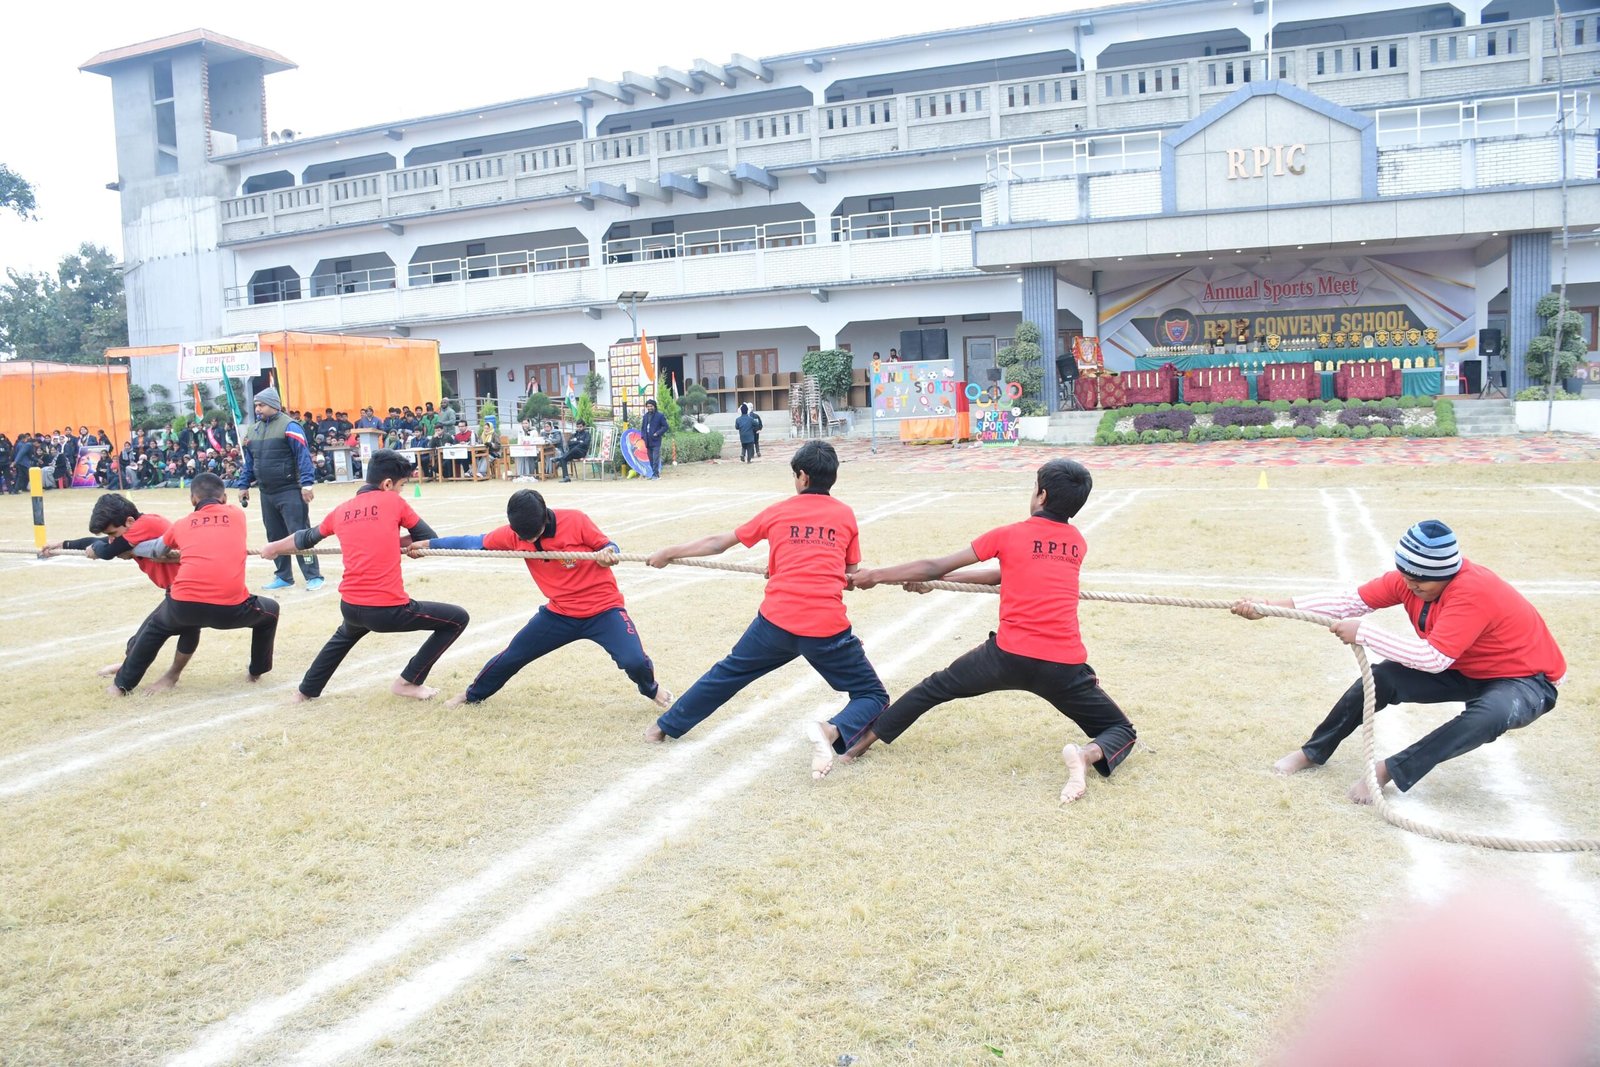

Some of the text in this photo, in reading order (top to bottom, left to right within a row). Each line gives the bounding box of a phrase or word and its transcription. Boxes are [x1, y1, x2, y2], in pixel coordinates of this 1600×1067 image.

[1226, 143, 1306, 180] RPIC
[1203, 276, 1358, 303] Annual Sports Meet
[1255, 314, 1335, 337] CONVENT
[1341, 311, 1409, 333] SCHOOL
[224, 364, 250, 373] OUSE)
[914, 380, 954, 394] SPORTS
[984, 411, 1008, 421] RPIC
[977, 421, 1014, 432] SPORTS
[976, 431, 1018, 440] CARNIVAL
[191, 515, 229, 526] RPIC
[344, 505, 378, 521] RPIC
[790, 525, 836, 541] RPIC
[1033, 541, 1078, 558] RPIC
